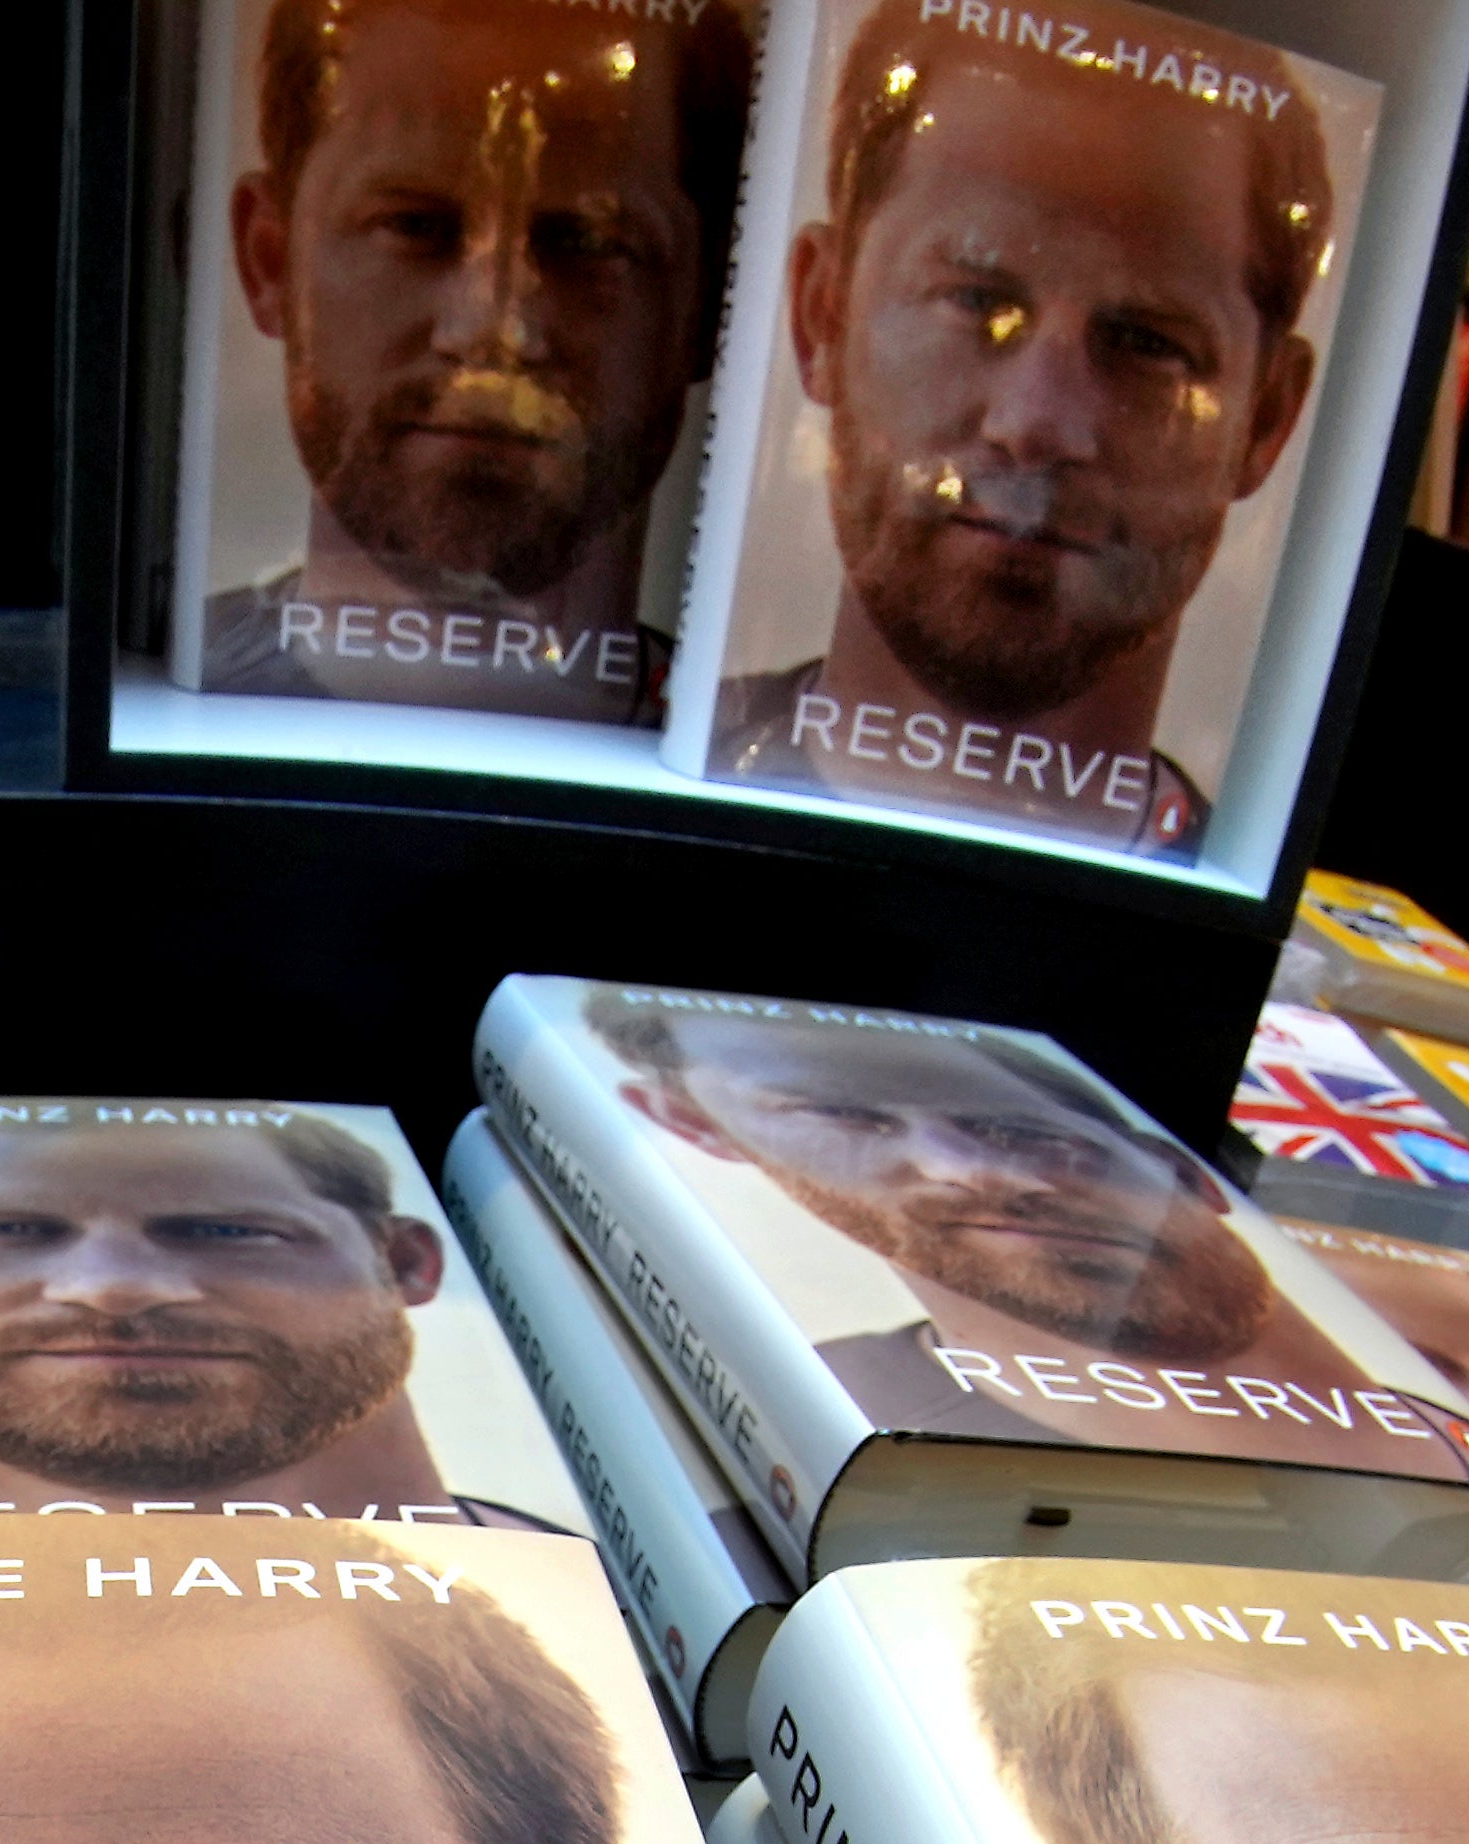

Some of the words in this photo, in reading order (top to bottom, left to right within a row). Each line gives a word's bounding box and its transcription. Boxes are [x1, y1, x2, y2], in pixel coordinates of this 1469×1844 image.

[918, 0, 1092, 62] PRINZ
[1112, 38, 1294, 123] HARRY
[275, 601, 640, 687] RESERVE
[790, 693, 1153, 811] RESERVE
[620, 987, 784, 1022] PRINZ
[810, 1008, 984, 1044] HARRY
[95, 1104, 296, 1130] HARRY
[629, 1249, 759, 1466] RESERVE
[932, 1345, 1432, 1440] RESERVE
[562, 1400, 660, 1618] RESERVE
[85, 1556, 465, 1606] HARRY
[1030, 1597, 1309, 1648] PRINZ
